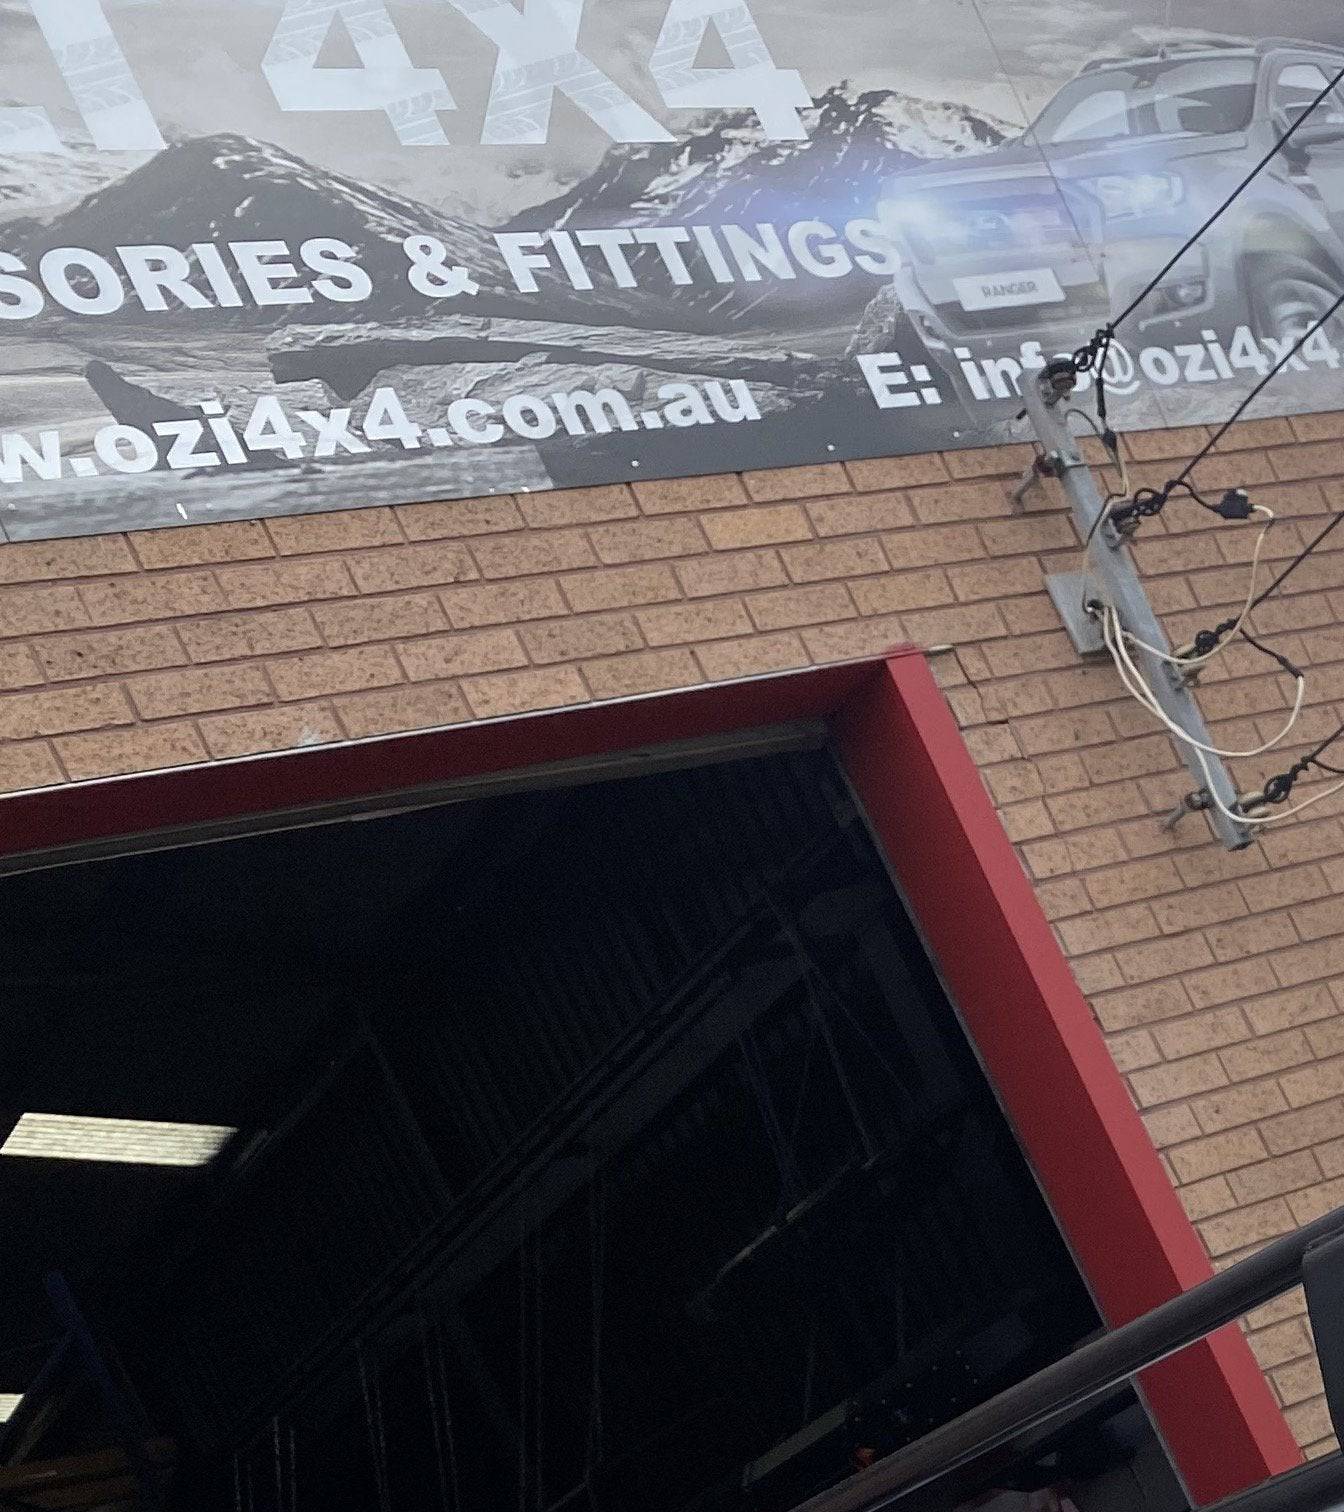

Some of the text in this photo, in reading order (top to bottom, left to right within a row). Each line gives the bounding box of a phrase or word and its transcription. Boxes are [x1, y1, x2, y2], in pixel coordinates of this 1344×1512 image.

[261, 0, 813, 146] 4X4
[0, 217, 901, 320] SORIES & FITTINGS
[980, 279, 1040, 298] RANGER
[0, 378, 762, 484] w.ozi4x4.com.au
[856, 351, 943, 409] E:
